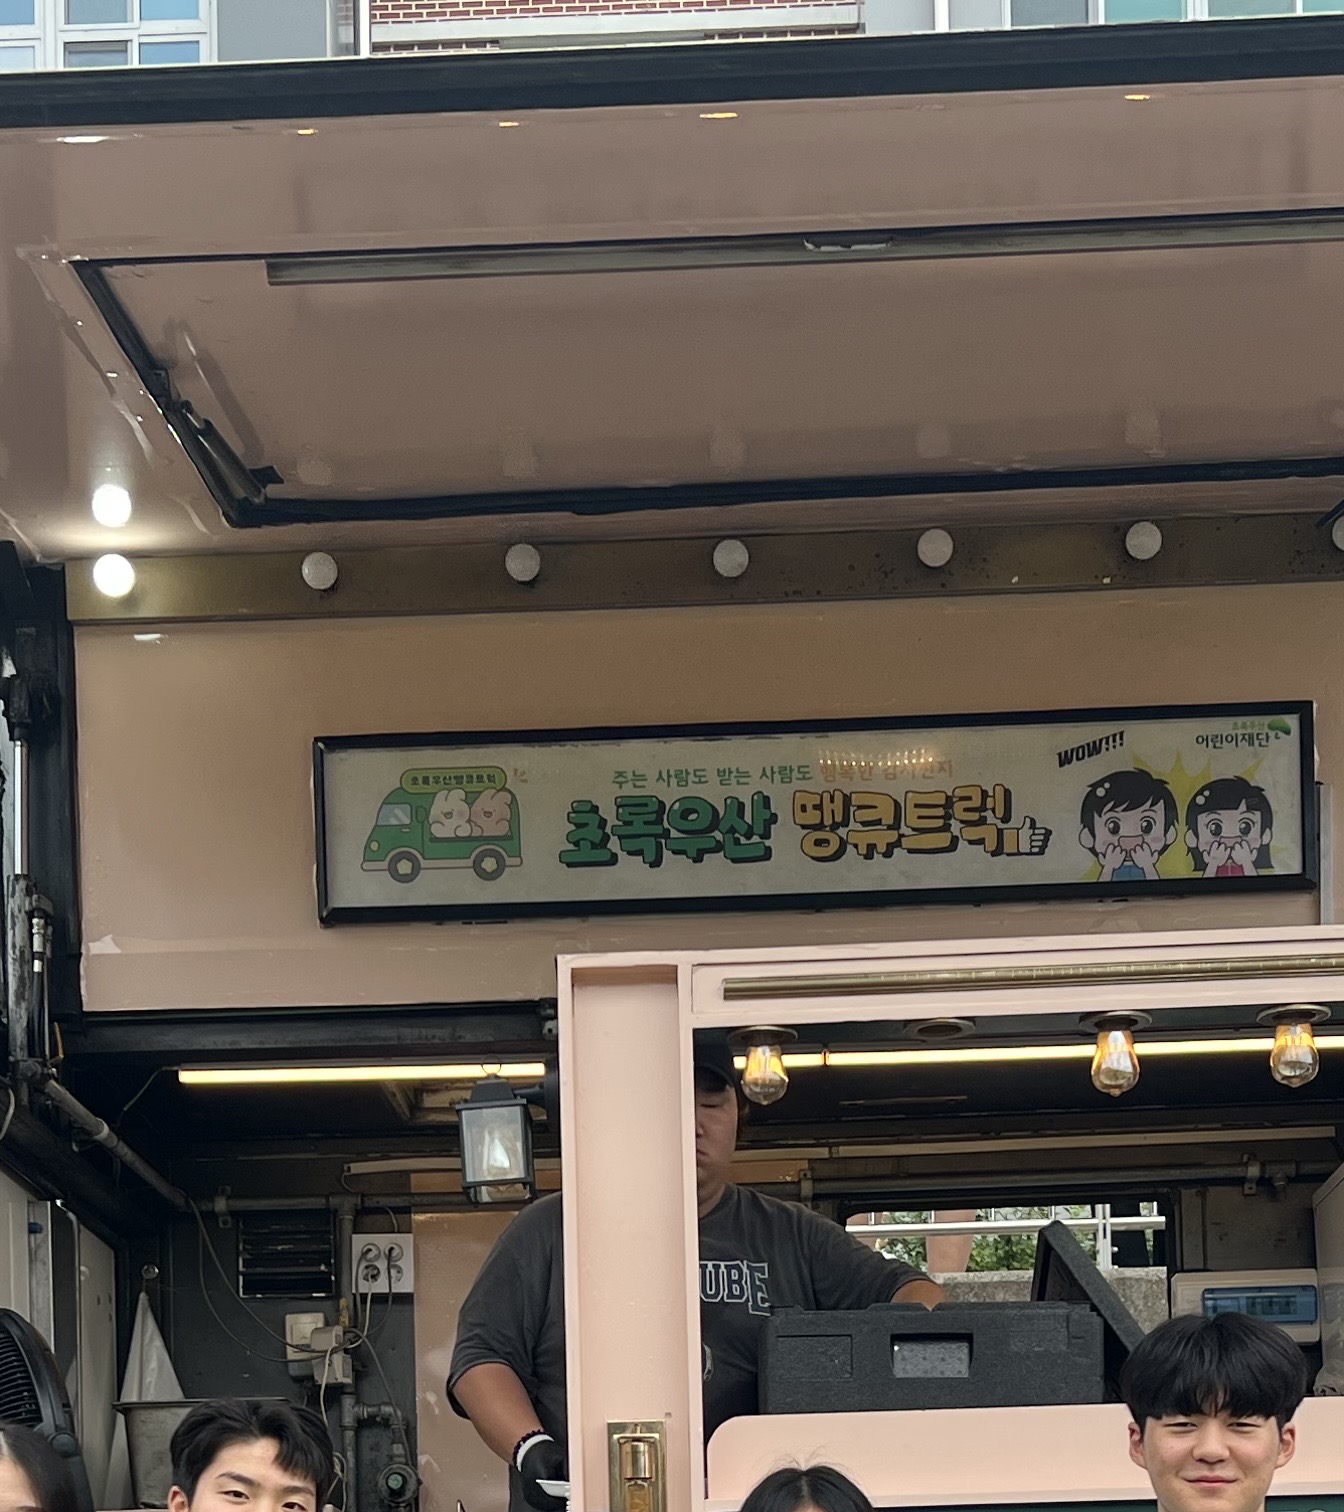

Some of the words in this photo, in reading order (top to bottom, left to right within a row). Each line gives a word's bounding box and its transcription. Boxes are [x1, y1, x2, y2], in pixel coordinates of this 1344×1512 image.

[1057, 730, 1125, 768] WOW!!!
[1196, 732, 1271, 749] 어린이재단
[612, 769, 648, 790] 주는
[657, 768, 709, 788] 사람도
[716, 766, 752, 786] 받는
[759, 764, 813, 784] 사람도
[559, 790, 778, 869] 초록우산
[792, 783, 1014, 862] 땡큐트럭
